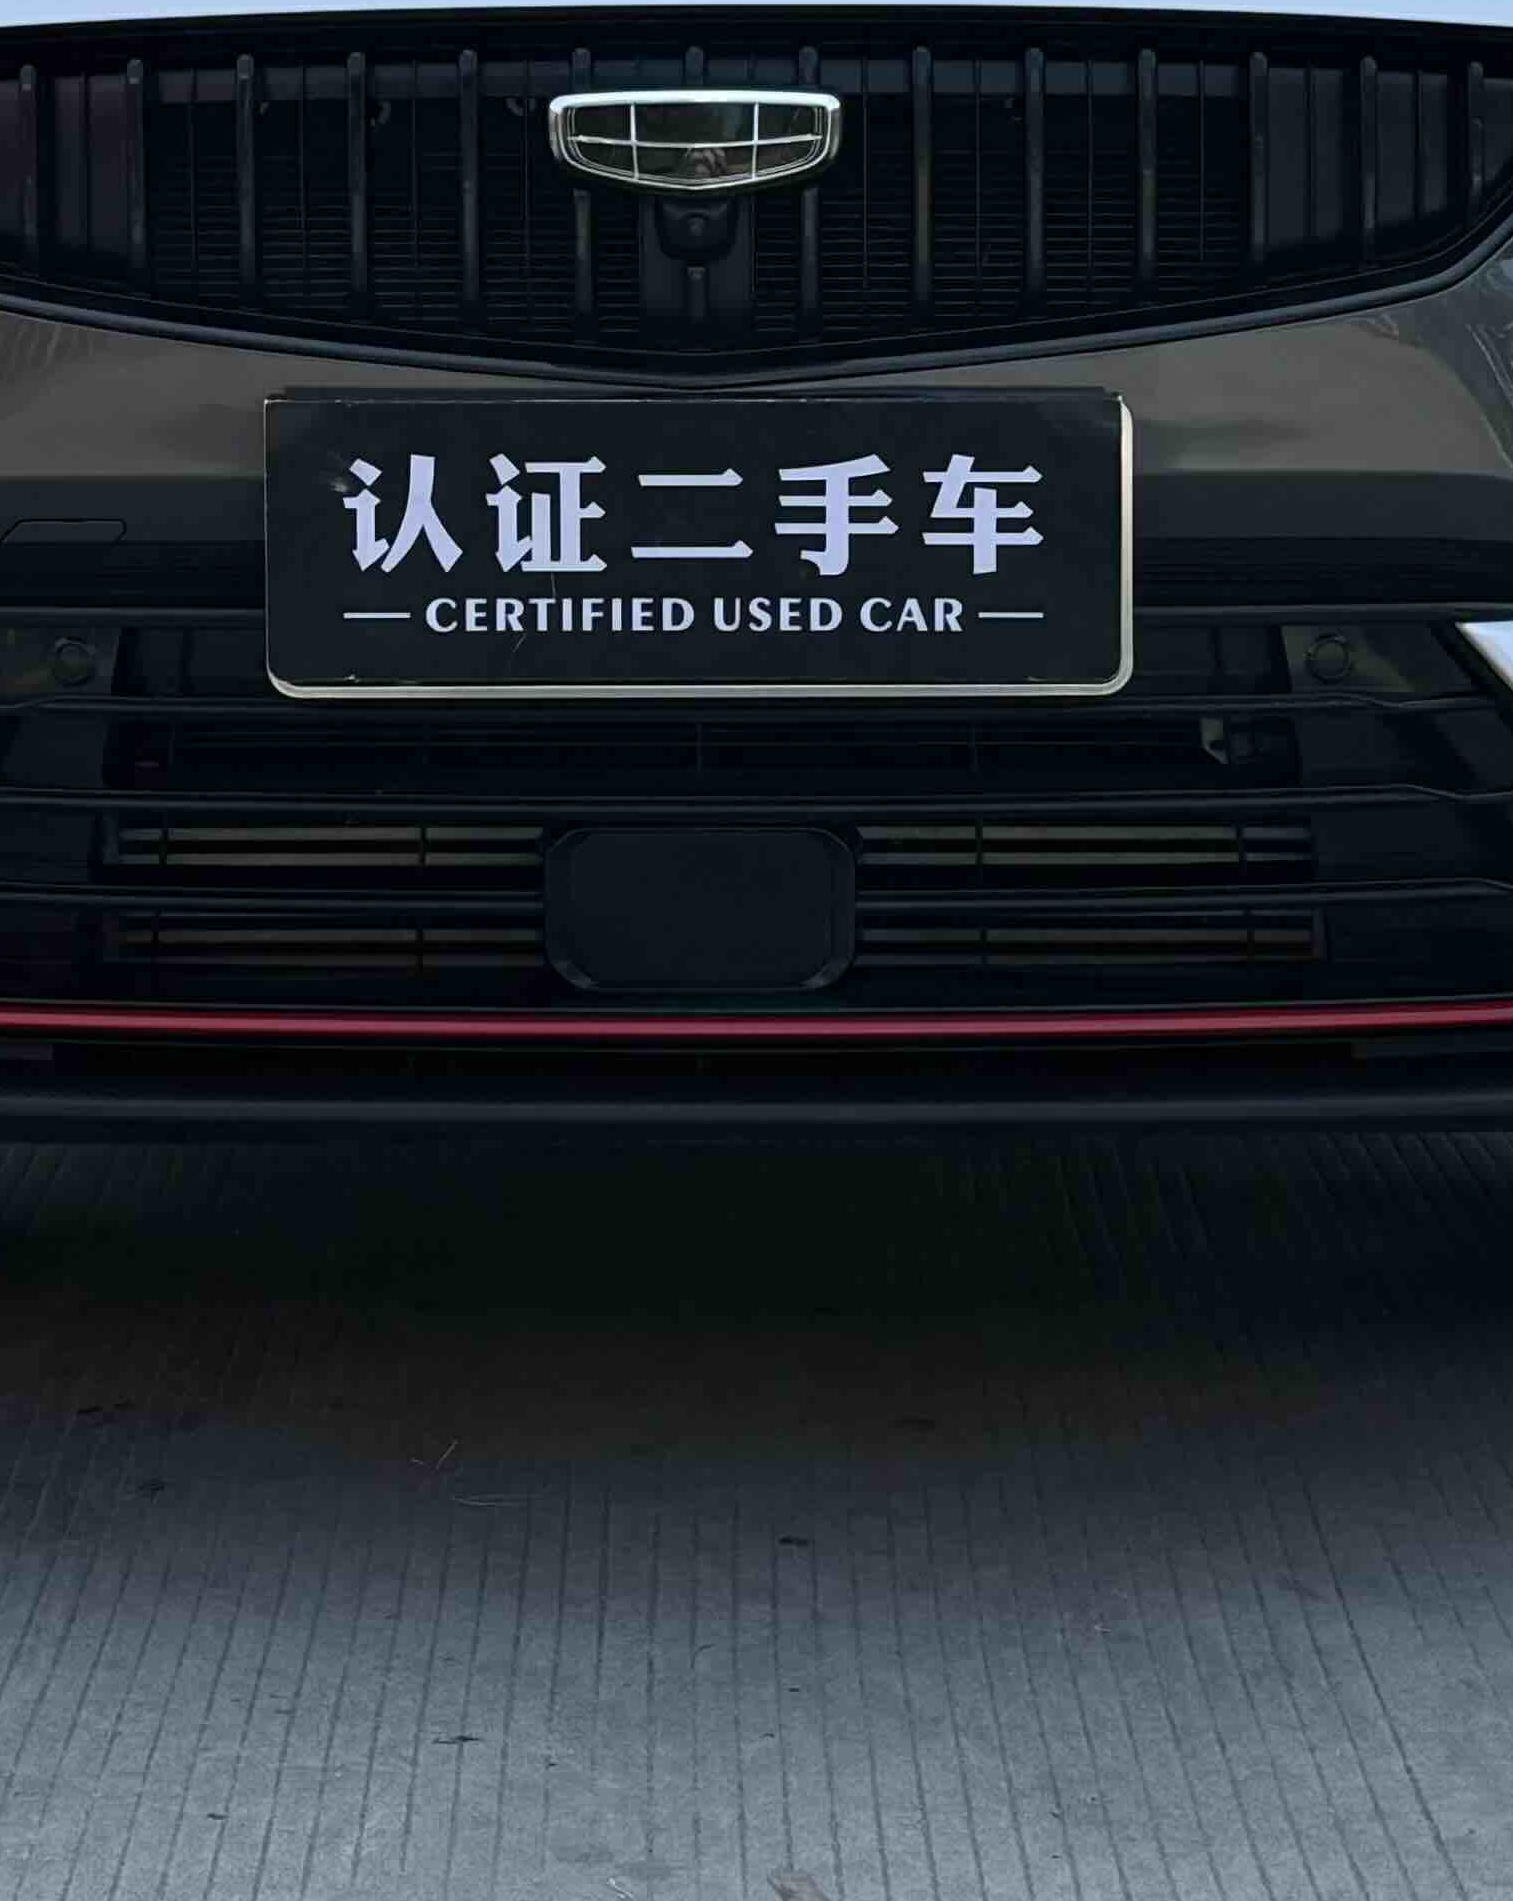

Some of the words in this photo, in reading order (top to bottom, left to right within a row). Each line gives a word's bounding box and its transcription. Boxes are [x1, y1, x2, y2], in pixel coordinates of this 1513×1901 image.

[341, 453, 1046, 577] 认证二手车
[425, 597, 695, 633] CERTIFIED
[714, 597, 843, 633] USED
[860, 597, 964, 633] CAR
